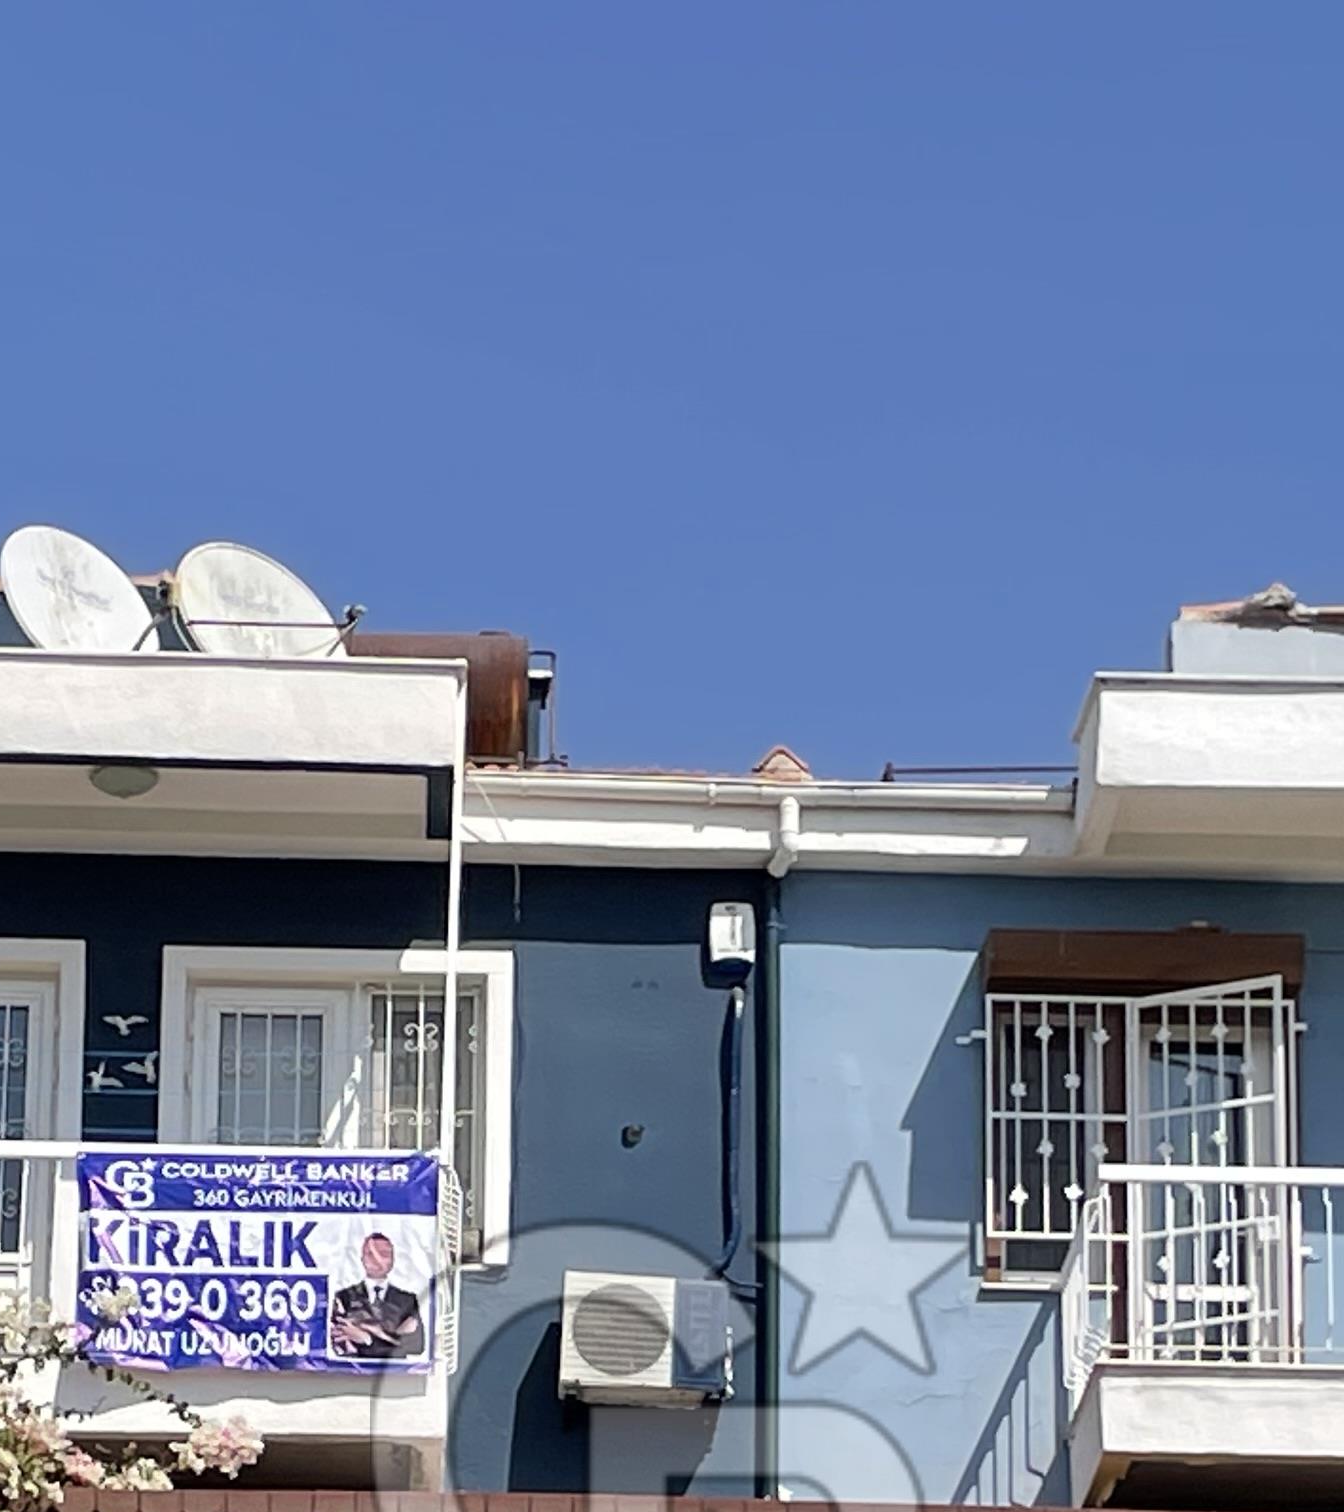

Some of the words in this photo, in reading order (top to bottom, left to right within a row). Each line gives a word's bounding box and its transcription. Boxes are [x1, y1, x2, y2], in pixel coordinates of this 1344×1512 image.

[161, 1161, 299, 1183] COLDWELL
[307, 1163, 409, 1182] BANKER
[193, 1189, 229, 1207] 360
[201, 1279, 228, 1321] 0
[238, 1280, 317, 1322] 360
[95, 1326, 175, 1356] MURAT
